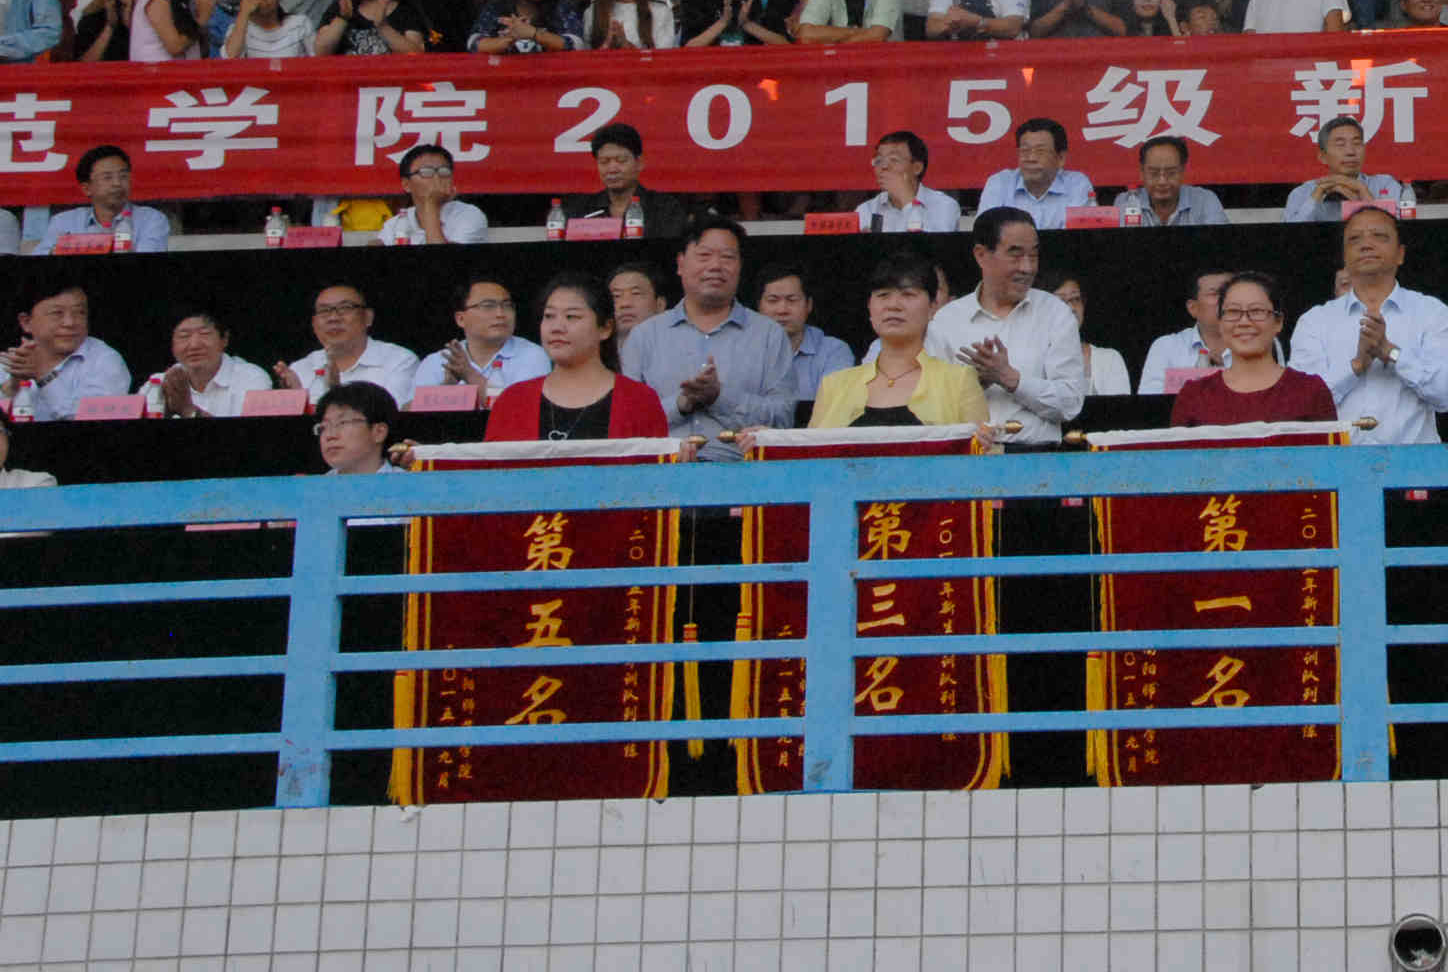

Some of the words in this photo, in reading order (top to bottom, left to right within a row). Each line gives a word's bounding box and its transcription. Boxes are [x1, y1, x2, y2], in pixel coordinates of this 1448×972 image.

[505, 512, 576, 725] 第五名
[855, 502, 911, 711] 第三名
[1192, 494, 1252, 708] 第一名
